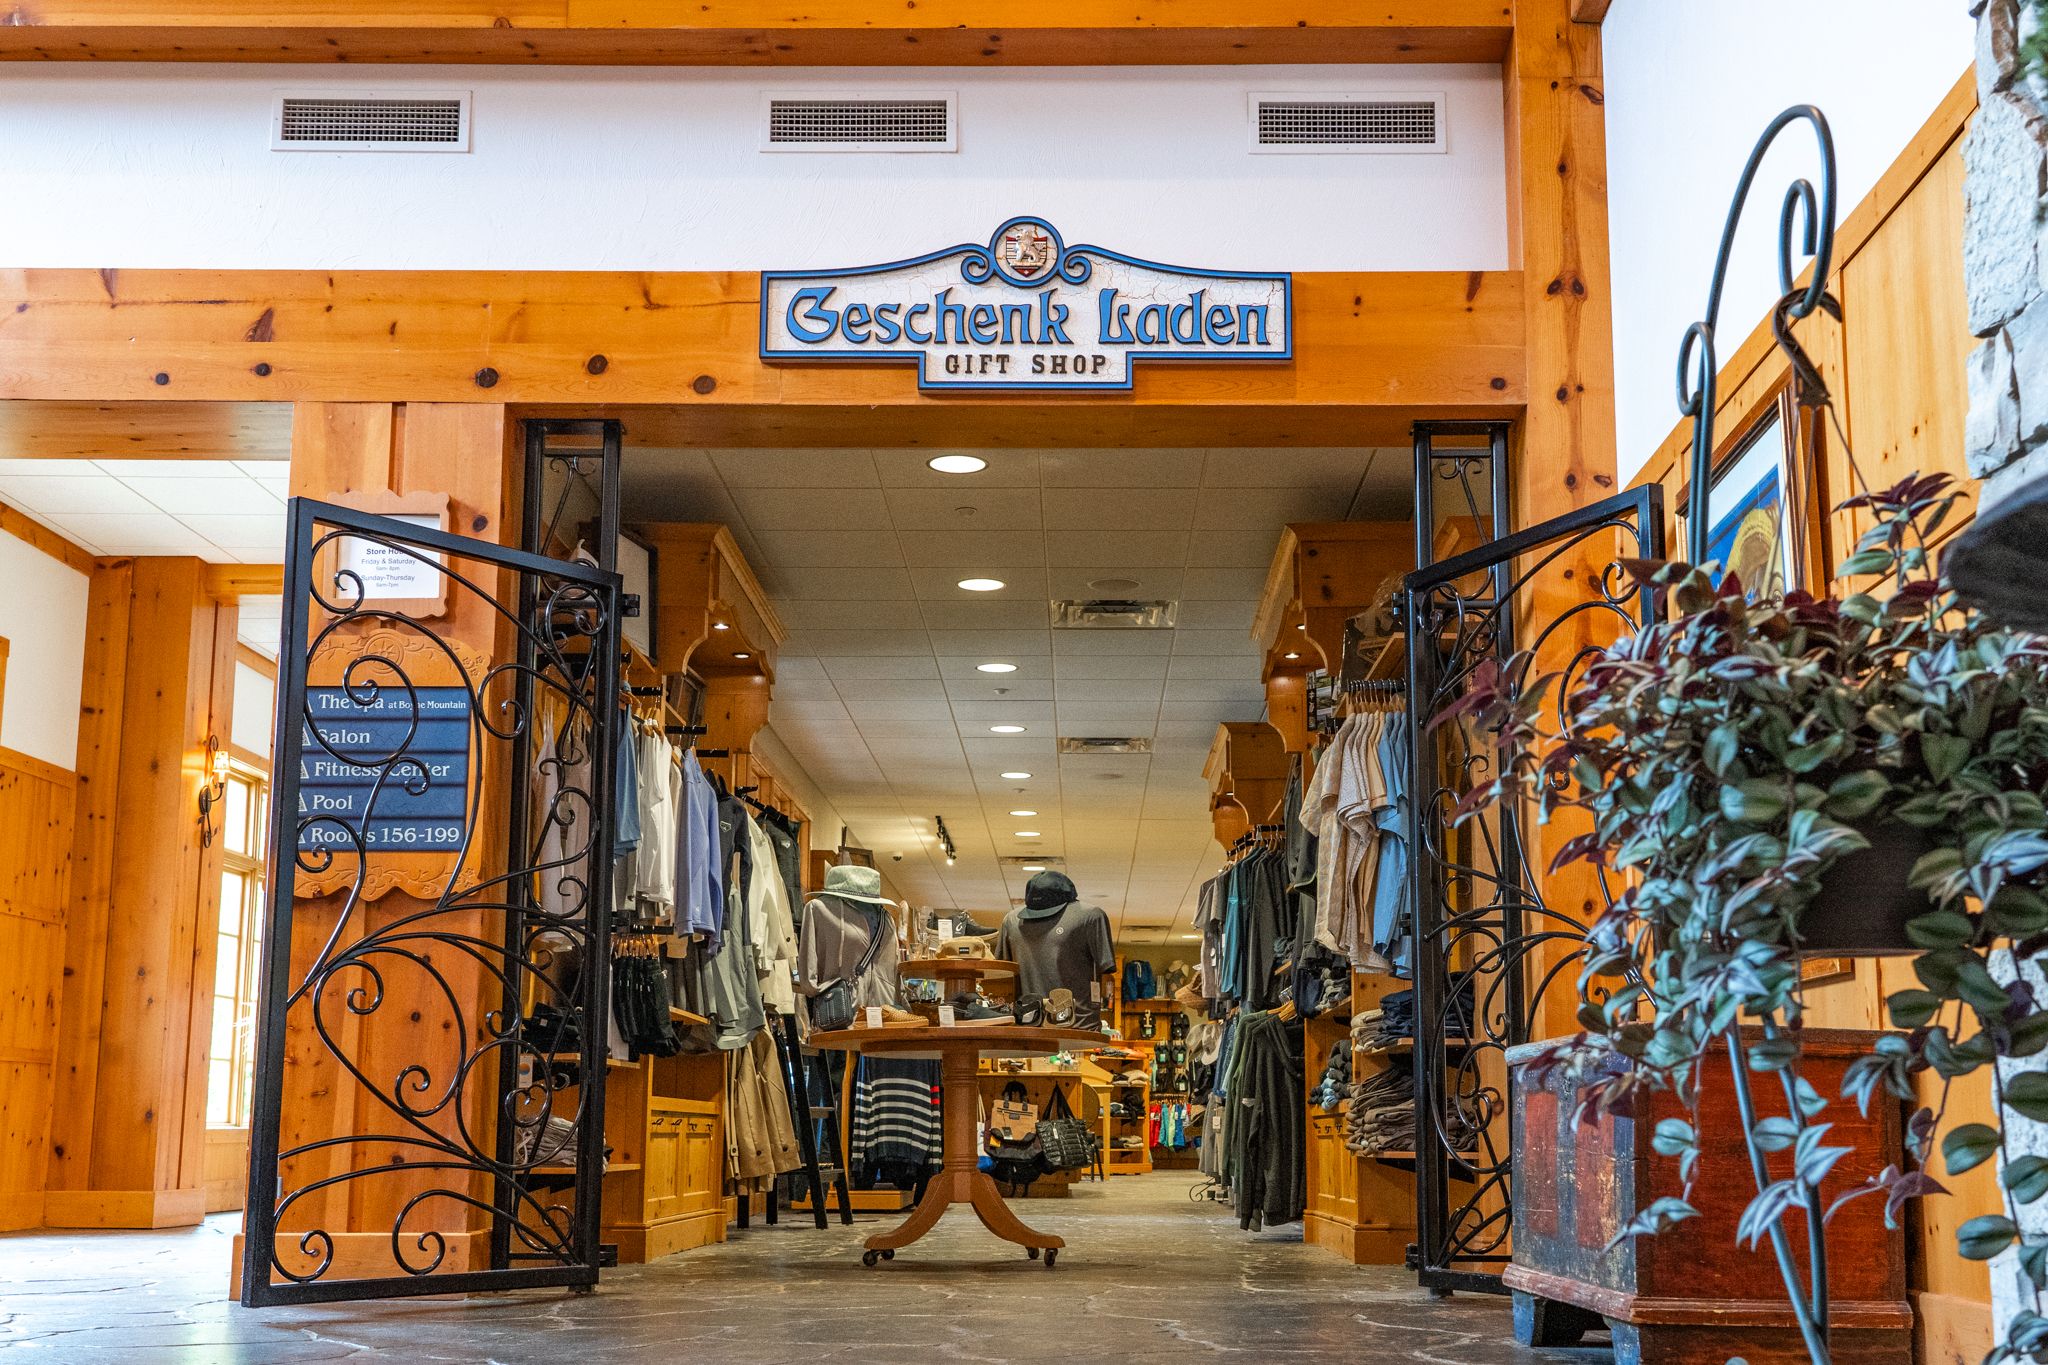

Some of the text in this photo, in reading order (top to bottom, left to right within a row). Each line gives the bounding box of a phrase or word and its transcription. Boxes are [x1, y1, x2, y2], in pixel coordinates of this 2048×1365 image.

[786, 286, 1271, 346] Geschenk Laden
[944, 354, 1107, 375] GIFT SHOP
[318, 694, 350, 709] The
[353, 694, 385, 713] Spa
[388, 701, 398, 709] at
[427, 700, 466, 709] Mountain
[317, 728, 371, 744] Salon
[314, 761, 381, 777] Fitness
[312, 794, 353, 810] Pool
[310, 827, 376, 843] Roos
